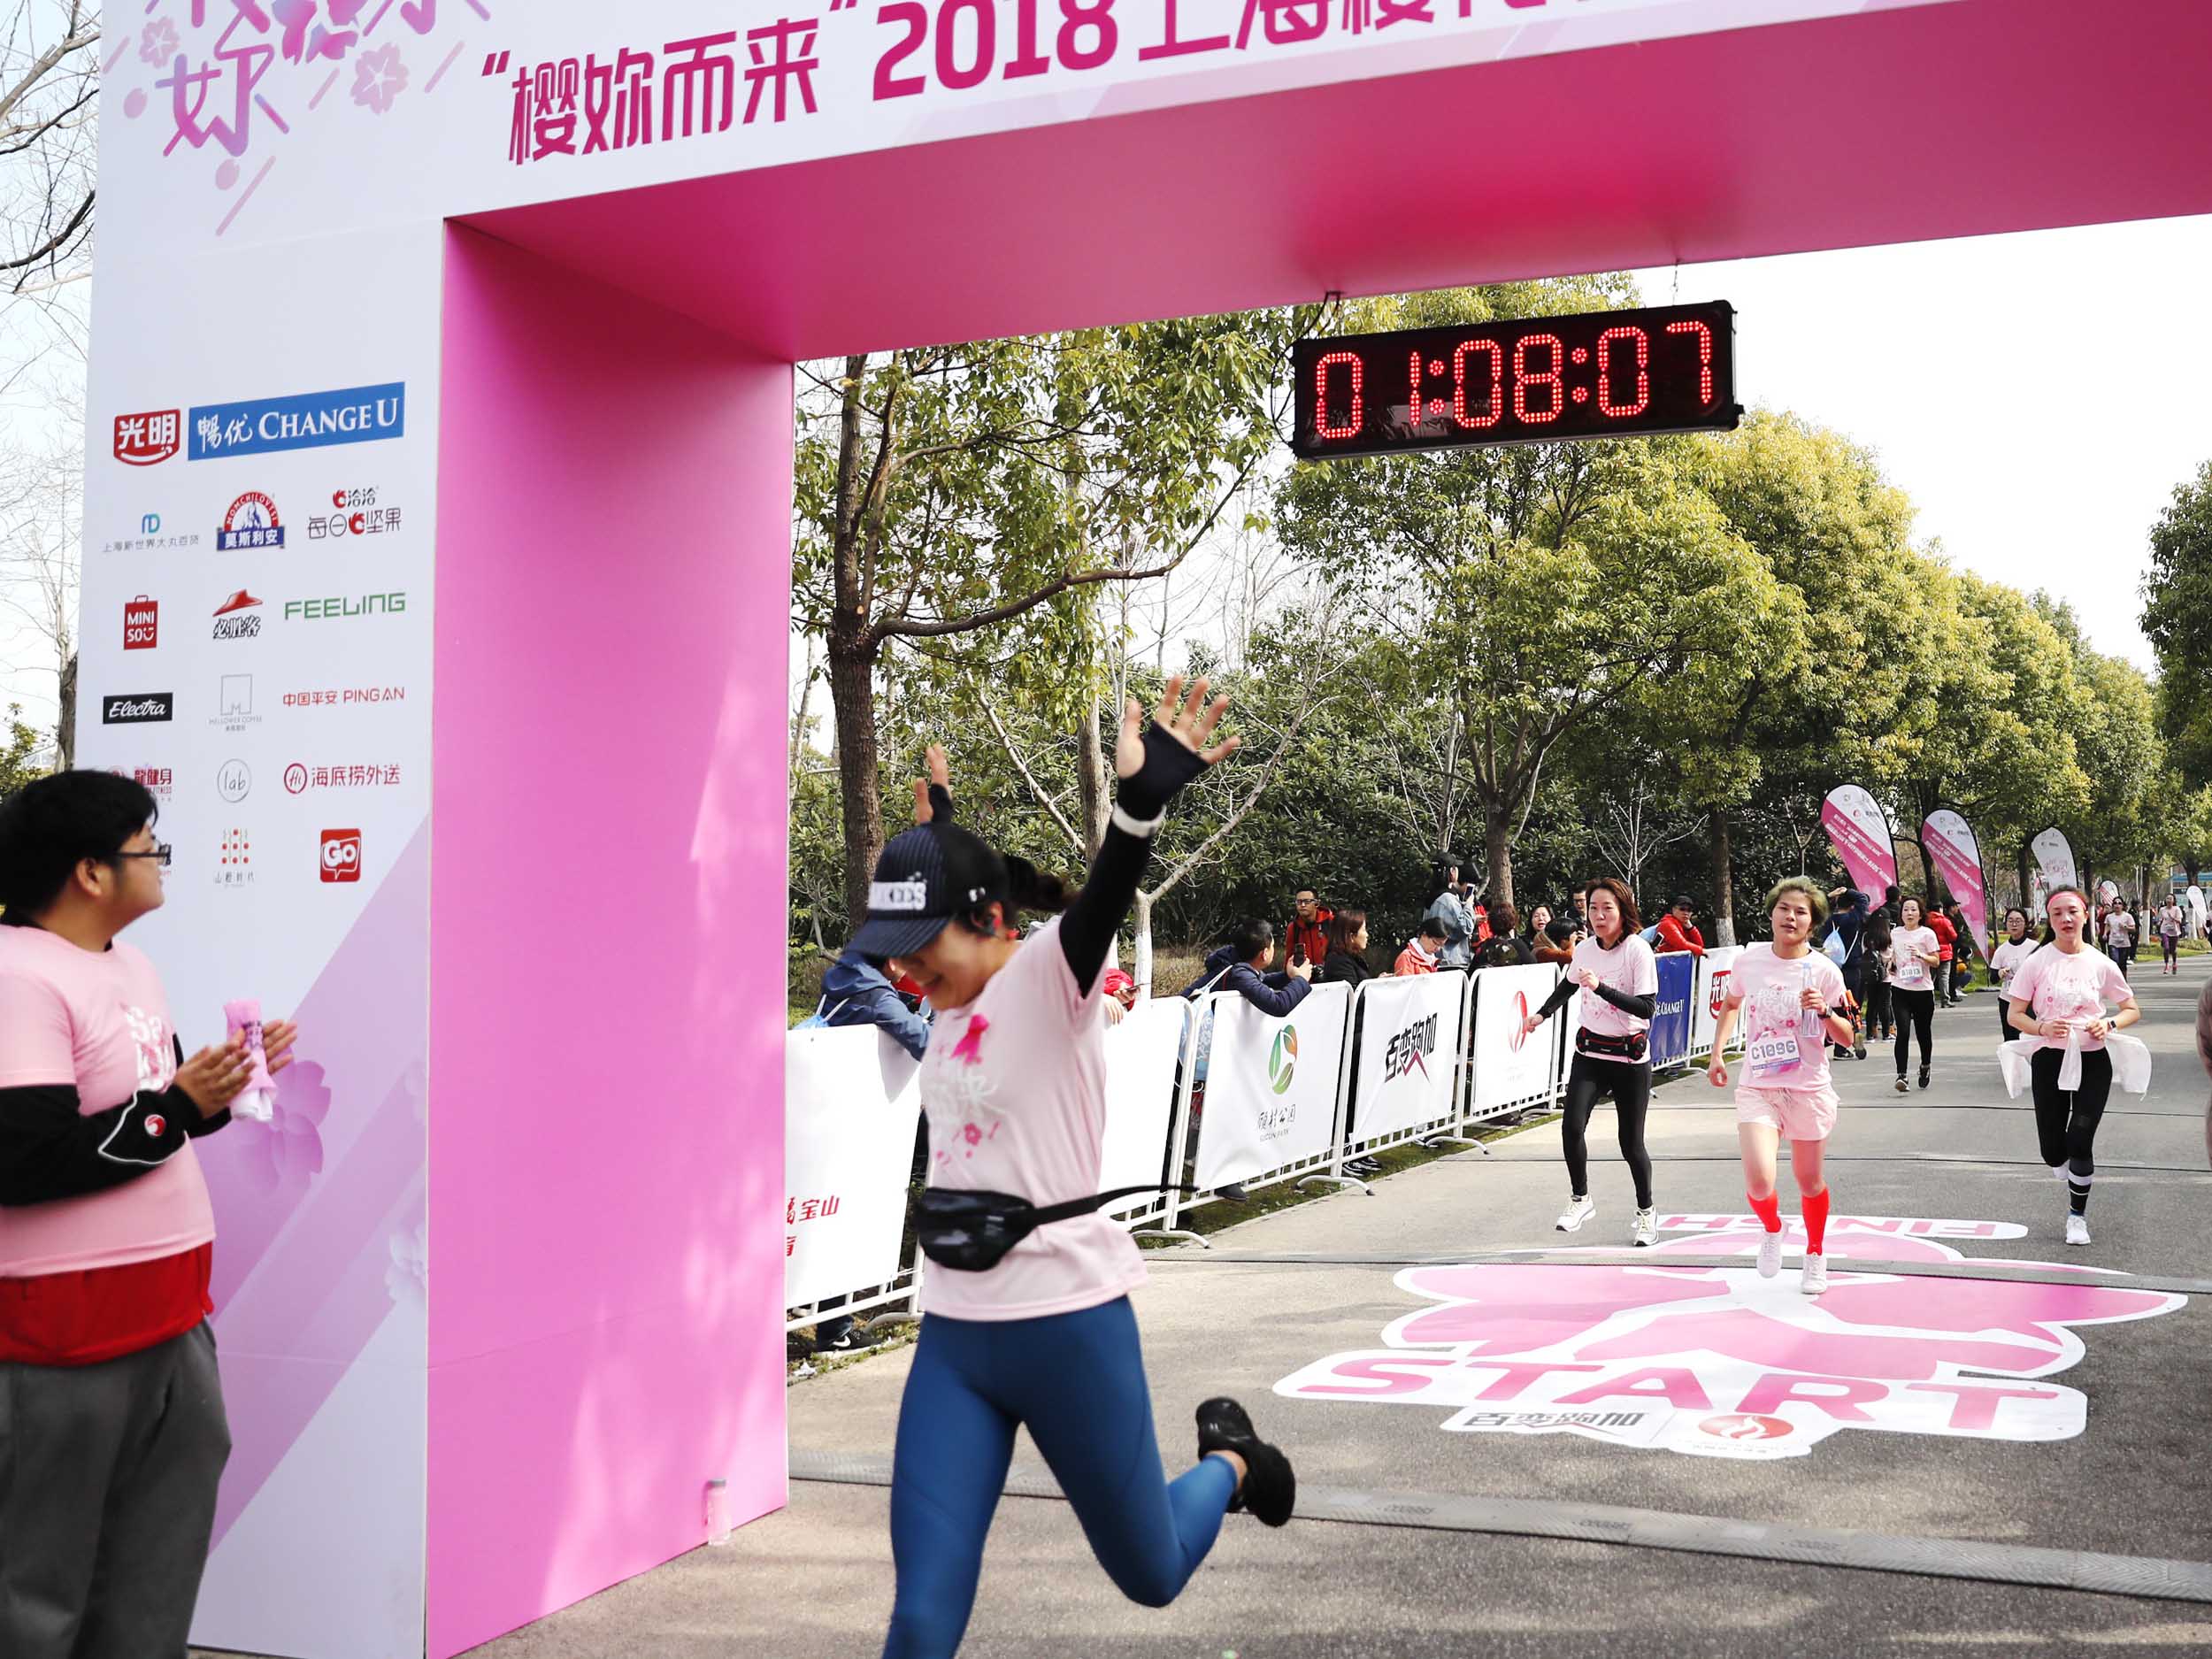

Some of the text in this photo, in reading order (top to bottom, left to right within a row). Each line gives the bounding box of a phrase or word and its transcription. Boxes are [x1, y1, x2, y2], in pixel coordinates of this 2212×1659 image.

[118, 412, 176, 449] 光明
[258, 404, 372, 441] CHANGE
[377, 398, 400, 426] U
[127, 611, 154, 625] MINI
[285, 593, 406, 620] FEELING
[109, 702, 166, 718] Electra
[283, 691, 338, 707] 中国平安
[225, 771, 246, 790] lab
[311, 764, 401, 787] 海底捞外送
[1297, 1358, 2058, 1432] START
